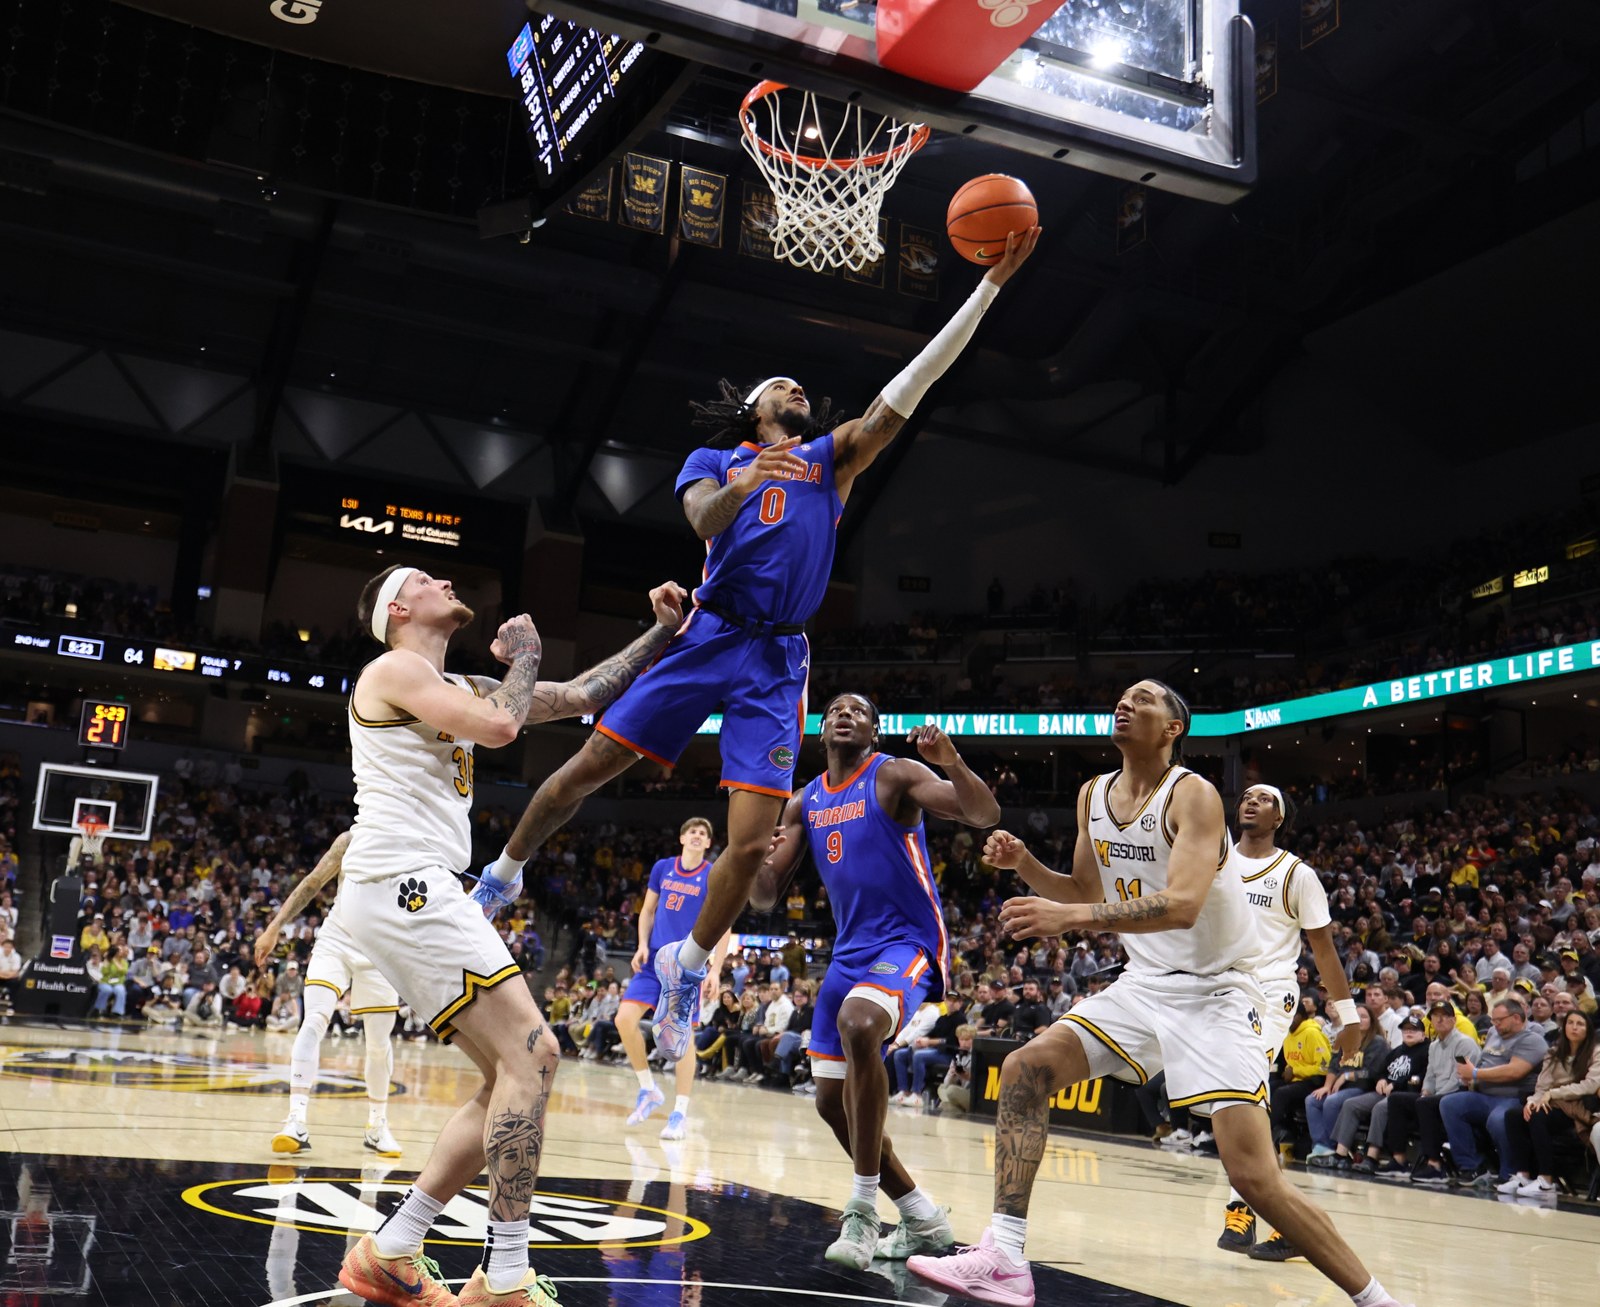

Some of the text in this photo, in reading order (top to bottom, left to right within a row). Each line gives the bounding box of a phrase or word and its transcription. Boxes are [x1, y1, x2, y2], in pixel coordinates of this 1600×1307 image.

[551, 33, 563, 55] LEE
[546, 85, 553, 97] 9
[575, 45, 582, 58] 8
[582, 36, 589, 49] 3
[588, 27, 596, 40] 5
[580, 70, 590, 86] 14
[588, 63, 595, 76] 3
[595, 54, 602, 67] 6
[521, 67, 535, 94] 58
[528, 95, 542, 121] 32
[559, 136, 567, 151] 21
[565, 108, 589, 142] CONDON
[588, 98, 597, 114] 12
[610, 69, 620, 86] 35
[536, 123, 549, 148] 14
[544, 154, 552, 175] 7
[700, 179, 720, 191] EIGHT
[690, 188, 714, 209] M
[342, 498, 359, 510] LSU
[386, 505, 397, 516] 72
[400, 508, 424, 521] TEXAS
[426, 513, 433, 522] A
[759, 487, 786, 525] 0
[403, 524, 460, 541] Kia of Columbia
[123, 648, 144, 665] 64
[234, 660, 242, 671] 7
[308, 675, 325, 688] 45
[1362, 687, 1378, 707] A
[1390, 664, 1493, 702] BETTER
[1508, 648, 1574, 681] LIFE
[95, 705, 126, 722] 5:23
[1255, 709, 1281, 726] BANK
[87, 717, 121, 743] 21
[973, 714, 1024, 735] WELL.
[1038, 714, 1087, 735] BANK
[808, 800, 865, 829] FLORIDA
[826, 831, 842, 864] 9
[1094, 839, 1156, 867] MISSOURI
[661, 879, 700, 897] FLORIDA
[1115, 878, 1141, 901] 11
[408, 895, 424, 911] M
[665, 893, 685, 912] 21
[34, 963, 84, 975] Edward Jones
[37, 980, 87, 993] Health Care
